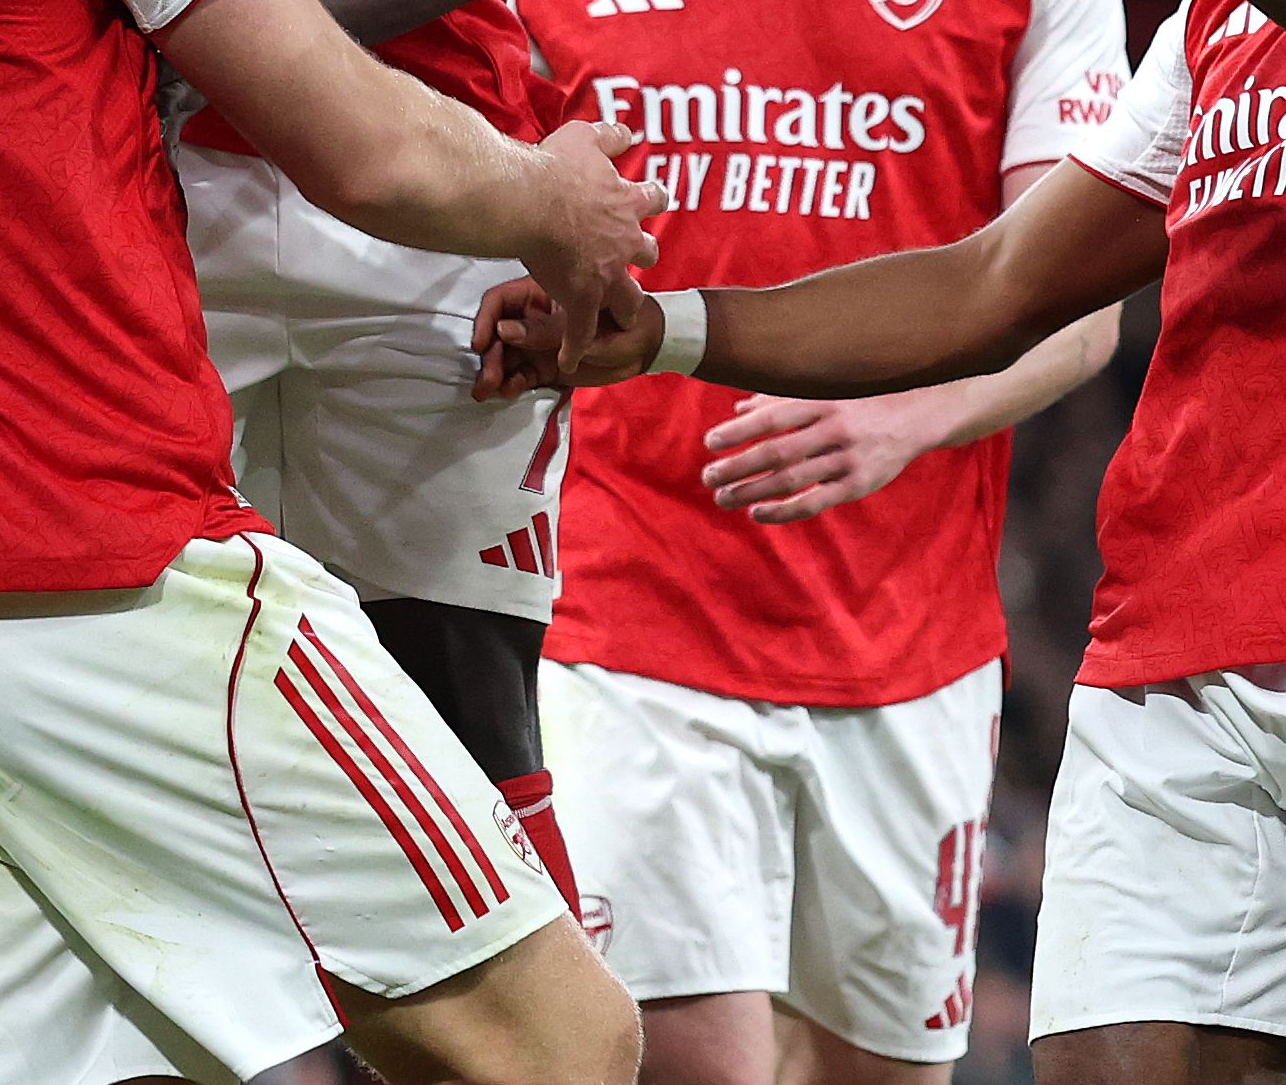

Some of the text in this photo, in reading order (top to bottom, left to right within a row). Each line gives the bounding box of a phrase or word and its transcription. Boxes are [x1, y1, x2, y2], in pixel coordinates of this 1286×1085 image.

[592, 67, 926, 153] Emirates
[720, 152, 877, 220] BETTER
[933, 813, 988, 957] 4
